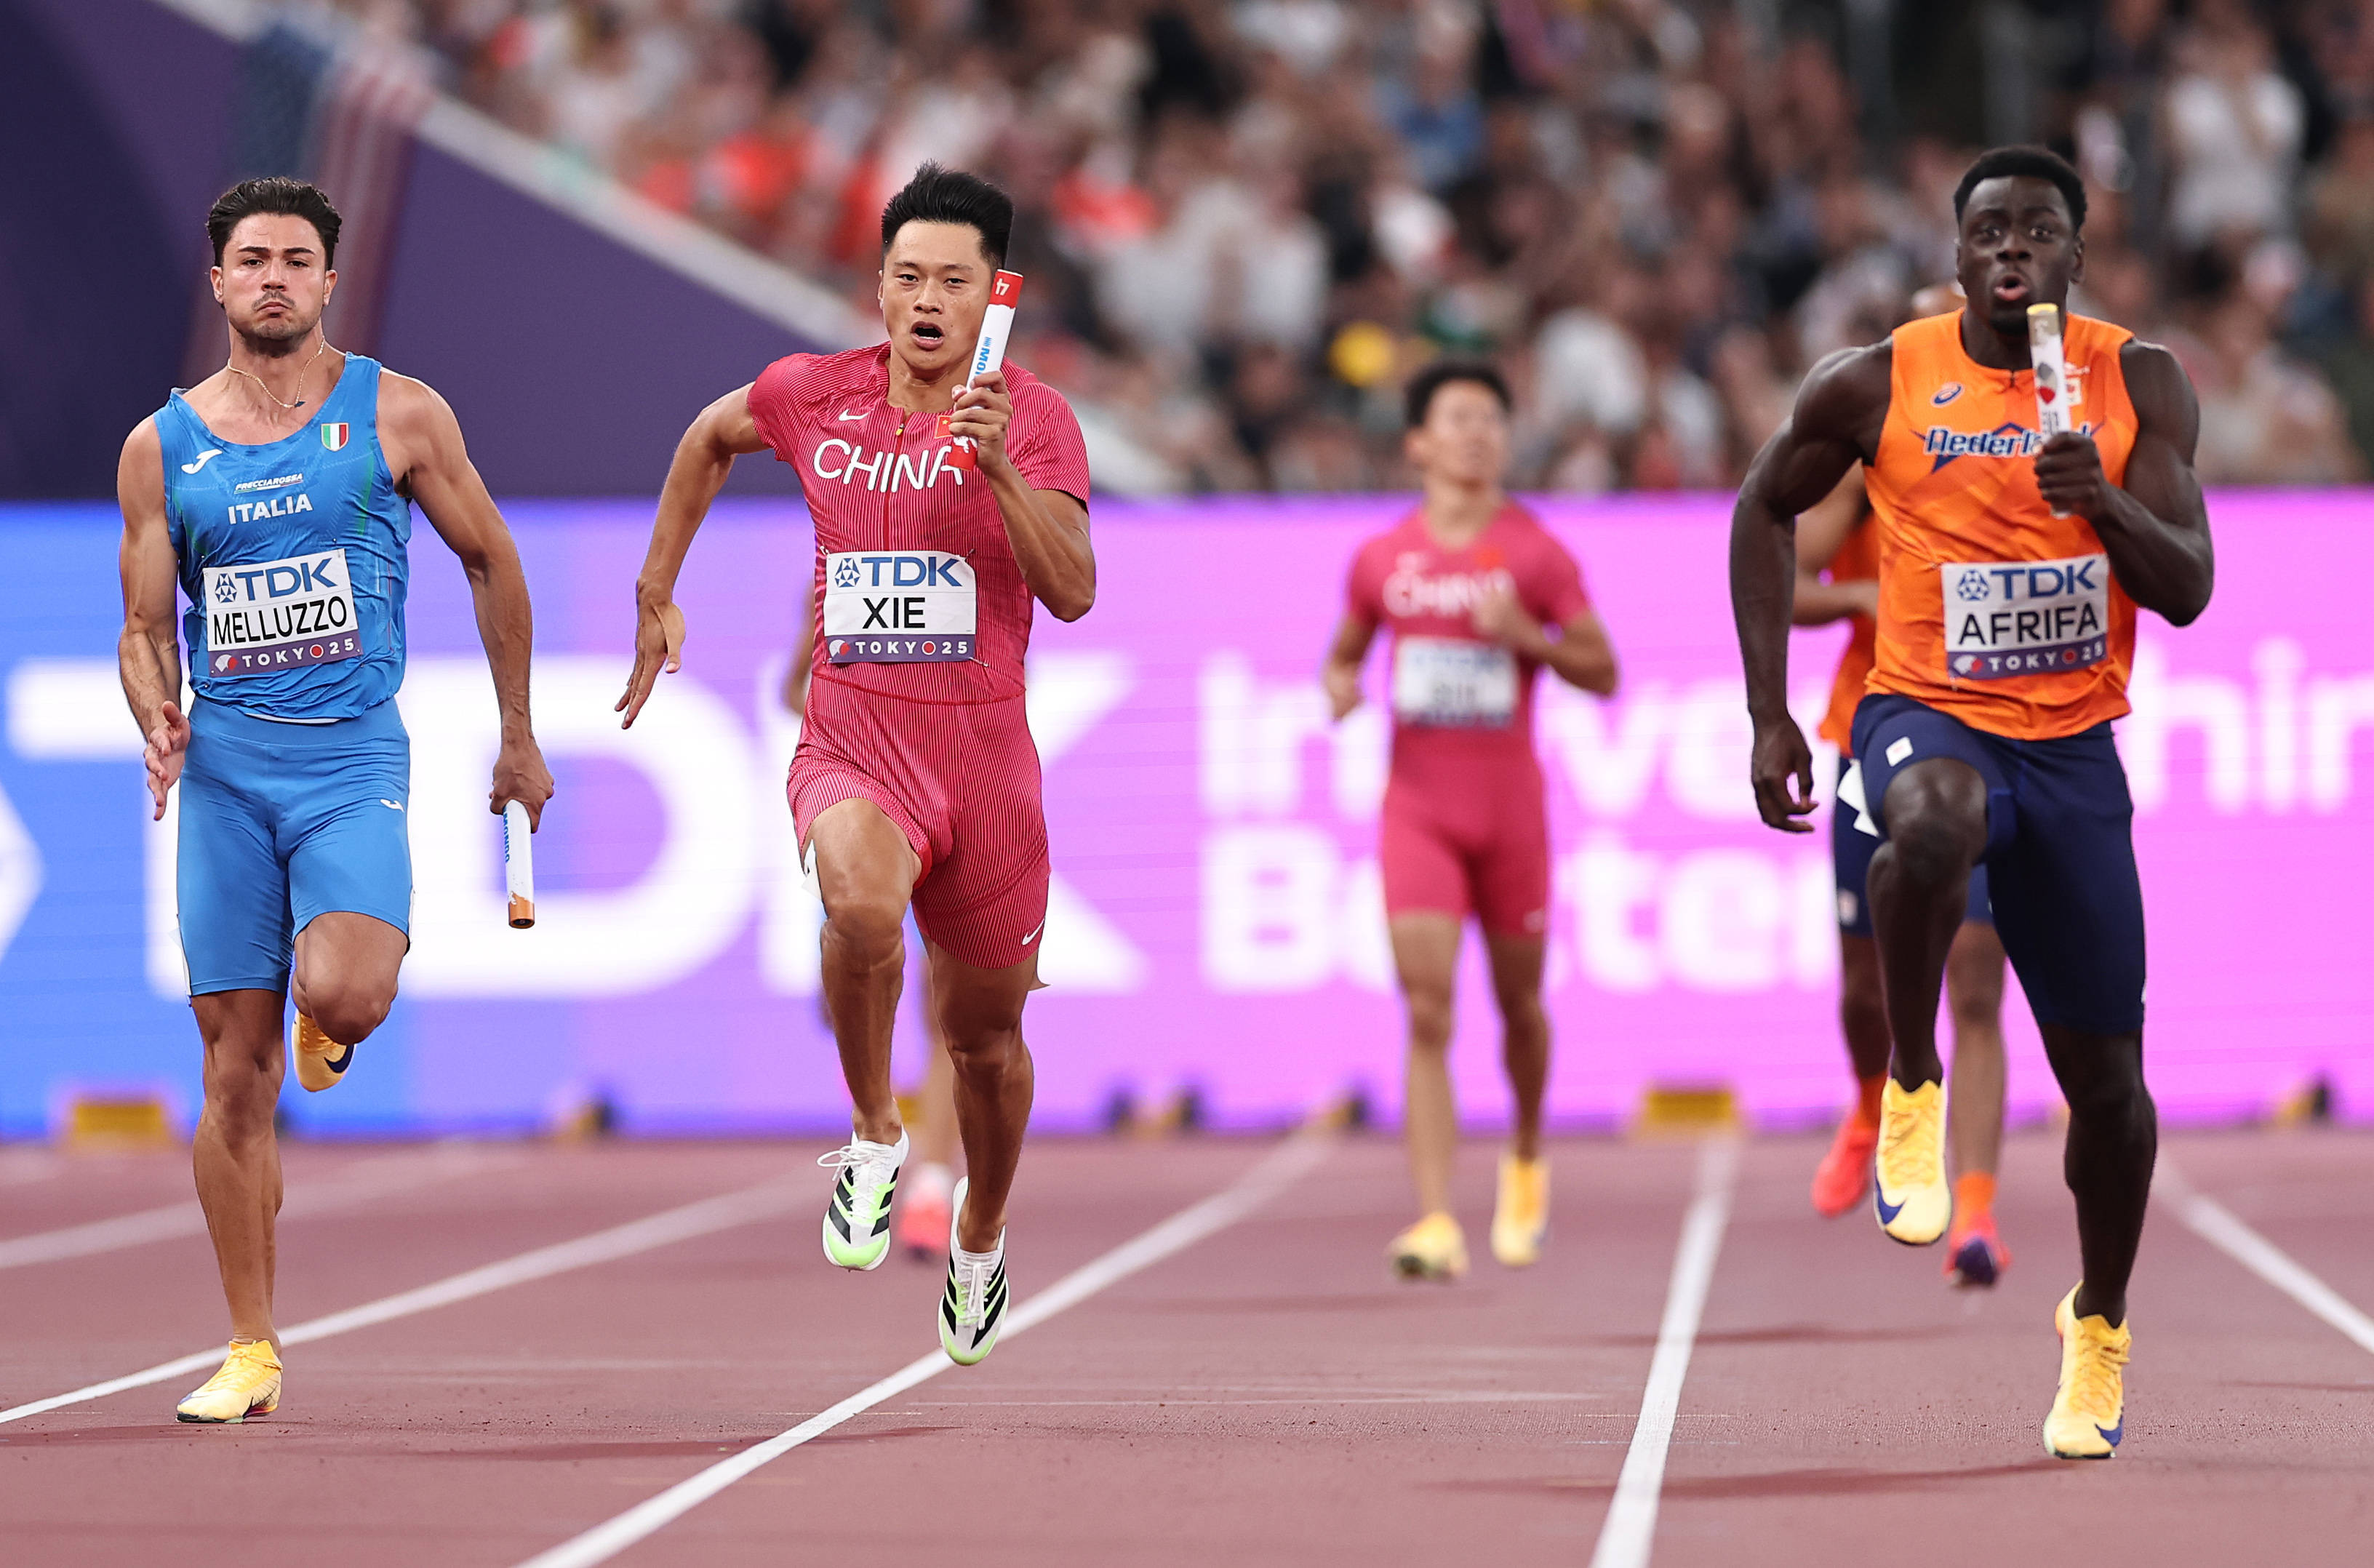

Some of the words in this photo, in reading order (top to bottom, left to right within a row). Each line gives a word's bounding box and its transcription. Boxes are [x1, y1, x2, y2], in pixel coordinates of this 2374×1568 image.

[995, 278, 1010, 295] 4
[235, 473, 303, 490] FRECCIAROSSA
[228, 493, 313, 524] ITALIA
[235, 557, 337, 601] TDK
[861, 556, 962, 587] TDK
[1990, 559, 2096, 600] TDK
[214, 596, 347, 645] MELLUZZO
[862, 597, 926, 629] XIE
[1959, 602, 2098, 645] AFRIFA
